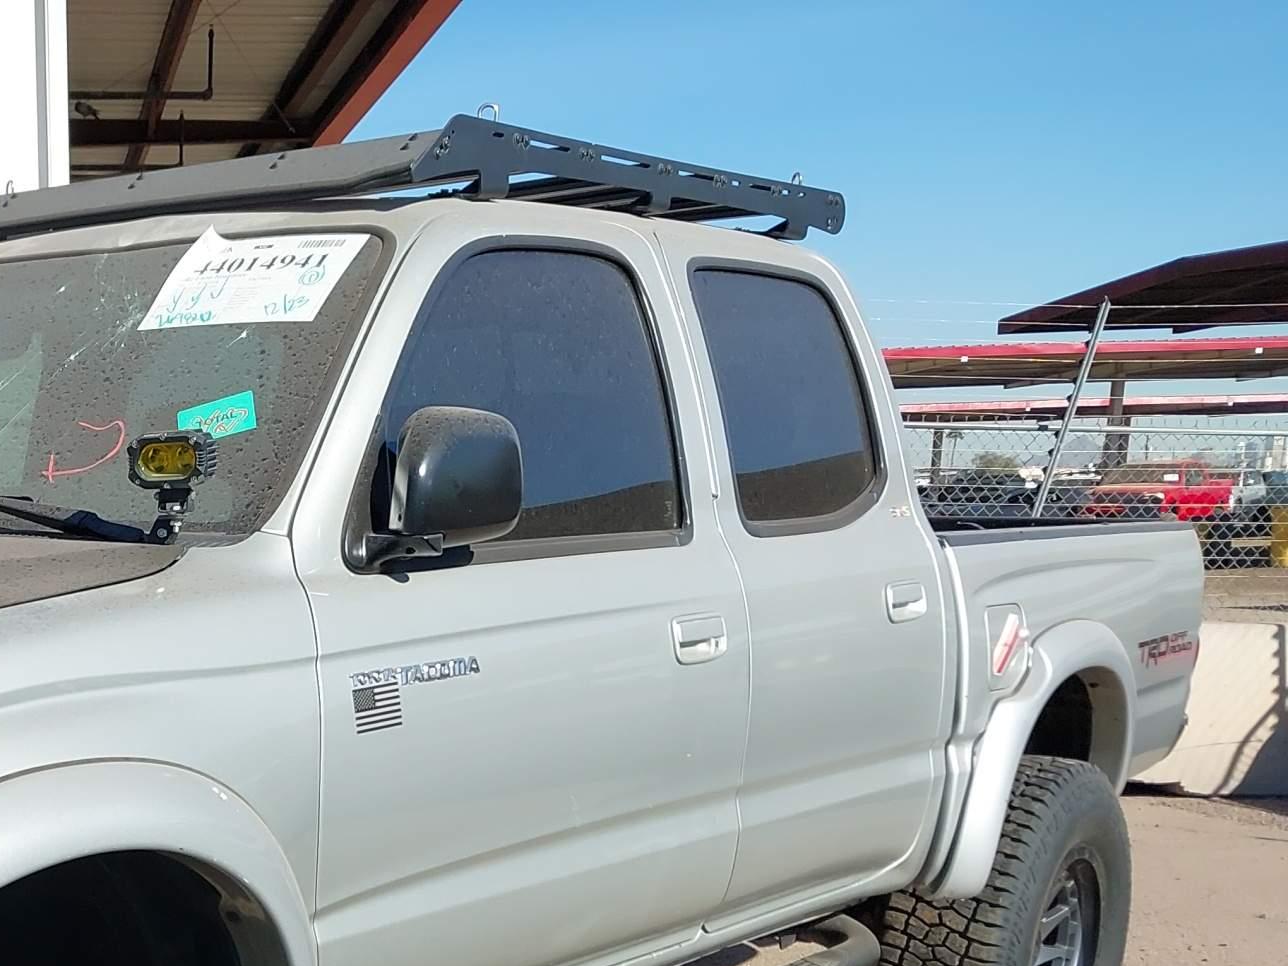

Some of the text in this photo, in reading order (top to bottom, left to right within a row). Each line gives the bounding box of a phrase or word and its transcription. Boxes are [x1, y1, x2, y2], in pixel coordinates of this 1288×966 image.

[195, 253, 329, 275] 44014941
[1138, 635, 1169, 668] TRD
[397, 656, 480, 686] TACOMA
